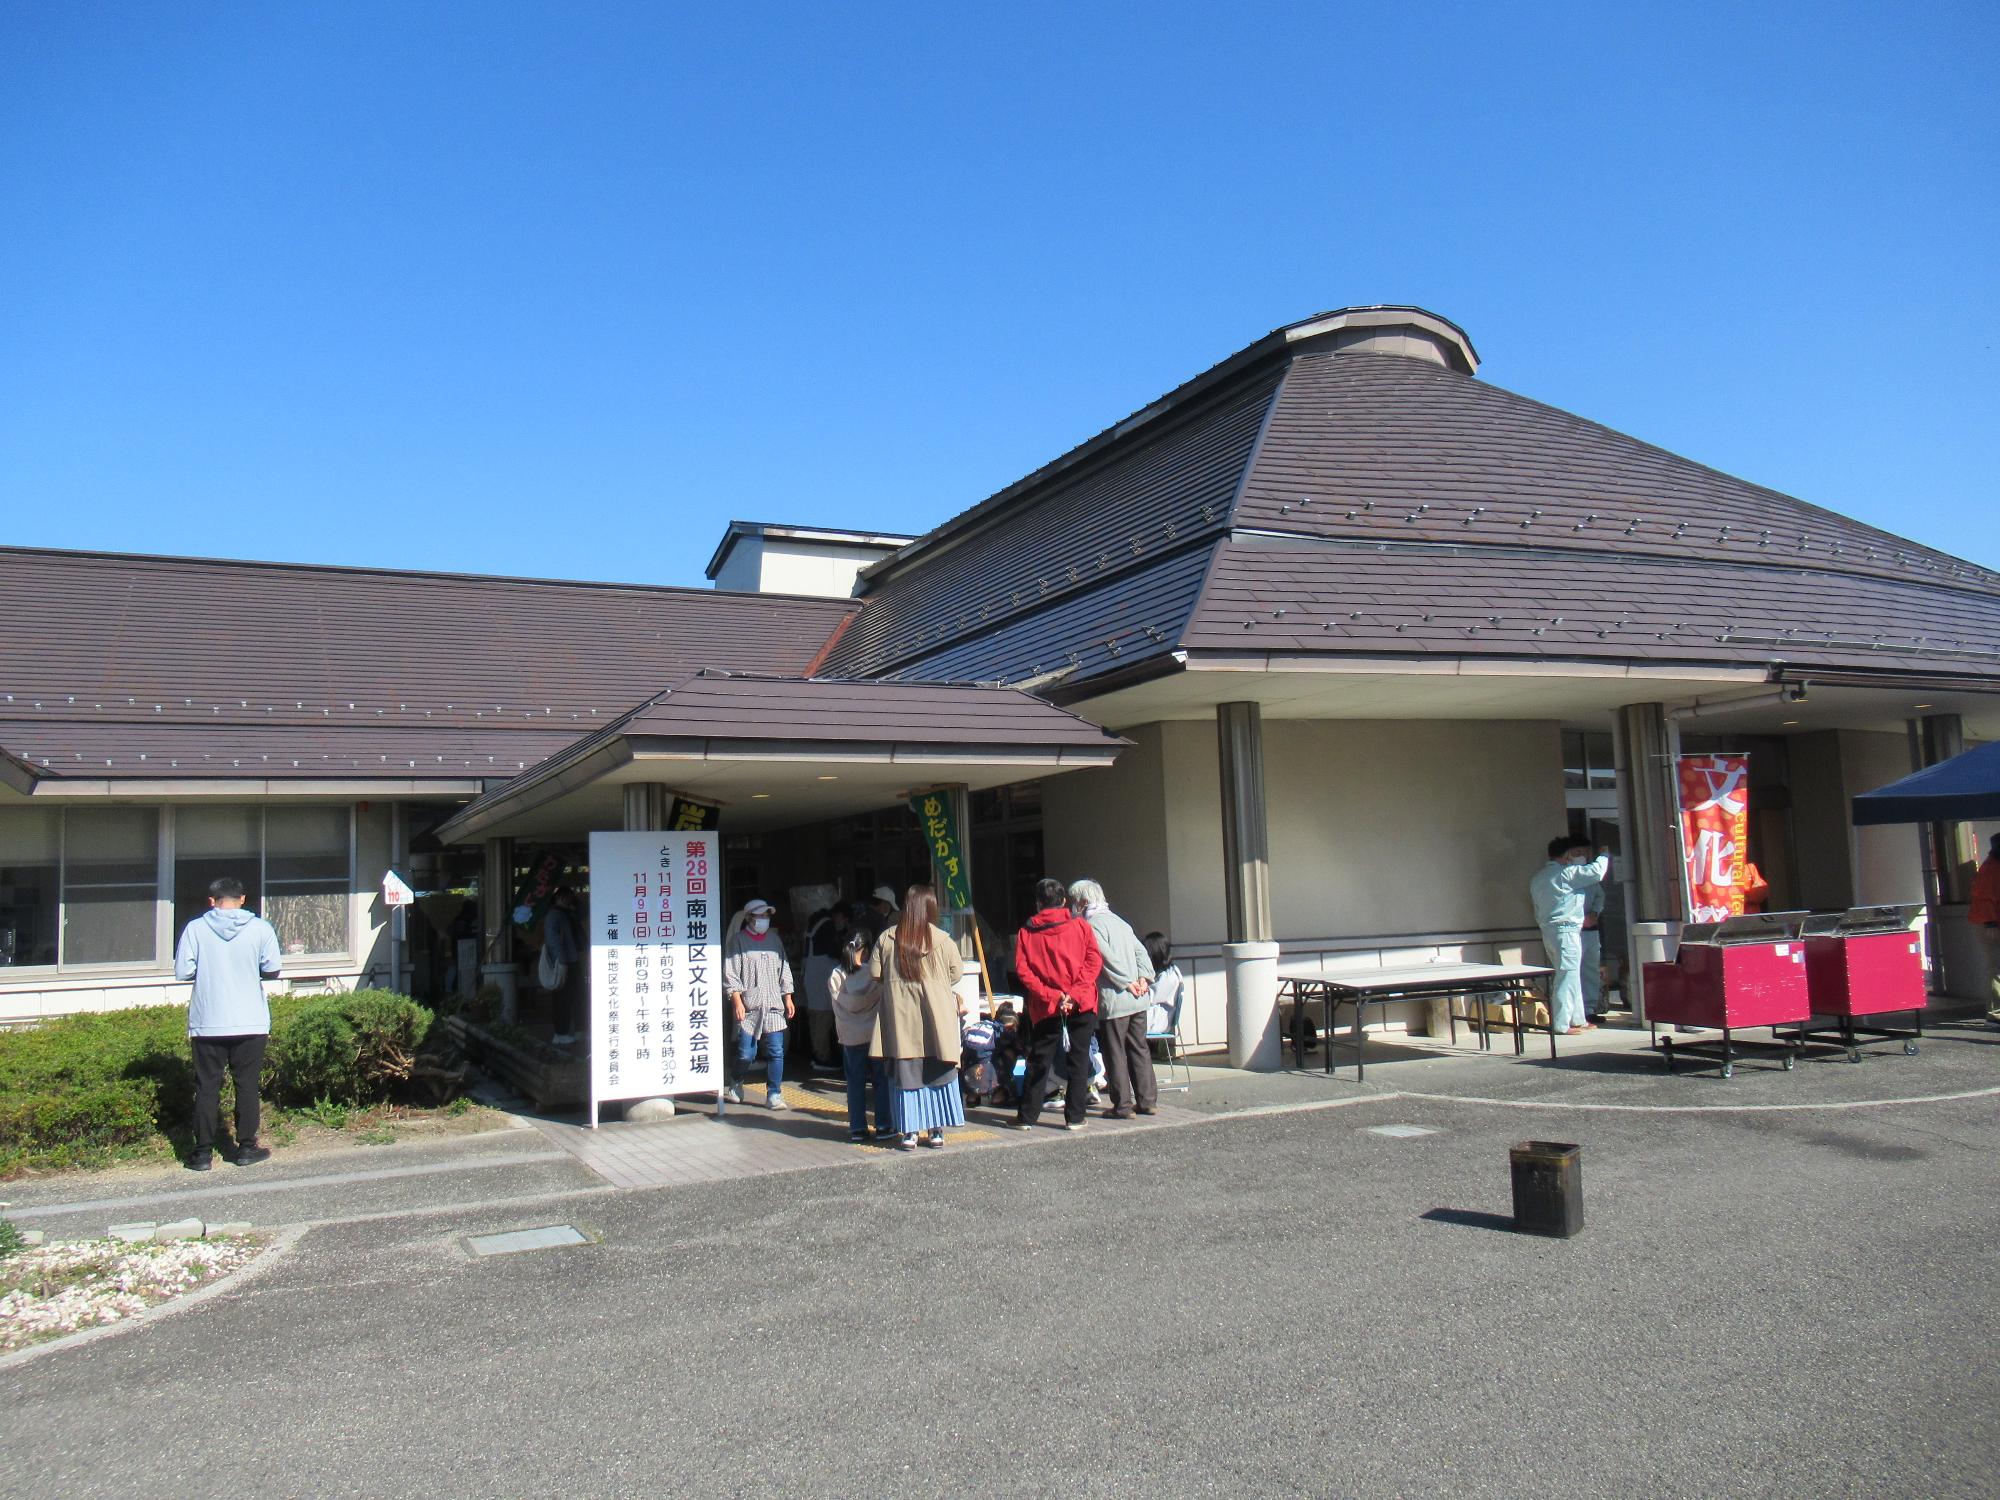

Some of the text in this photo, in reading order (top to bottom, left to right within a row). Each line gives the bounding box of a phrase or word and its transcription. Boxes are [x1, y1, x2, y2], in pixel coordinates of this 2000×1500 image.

[924, 798, 966, 909] めだかすくい
[1731, 812, 1747, 887] cultural
[388, 892, 400, 902] 110
